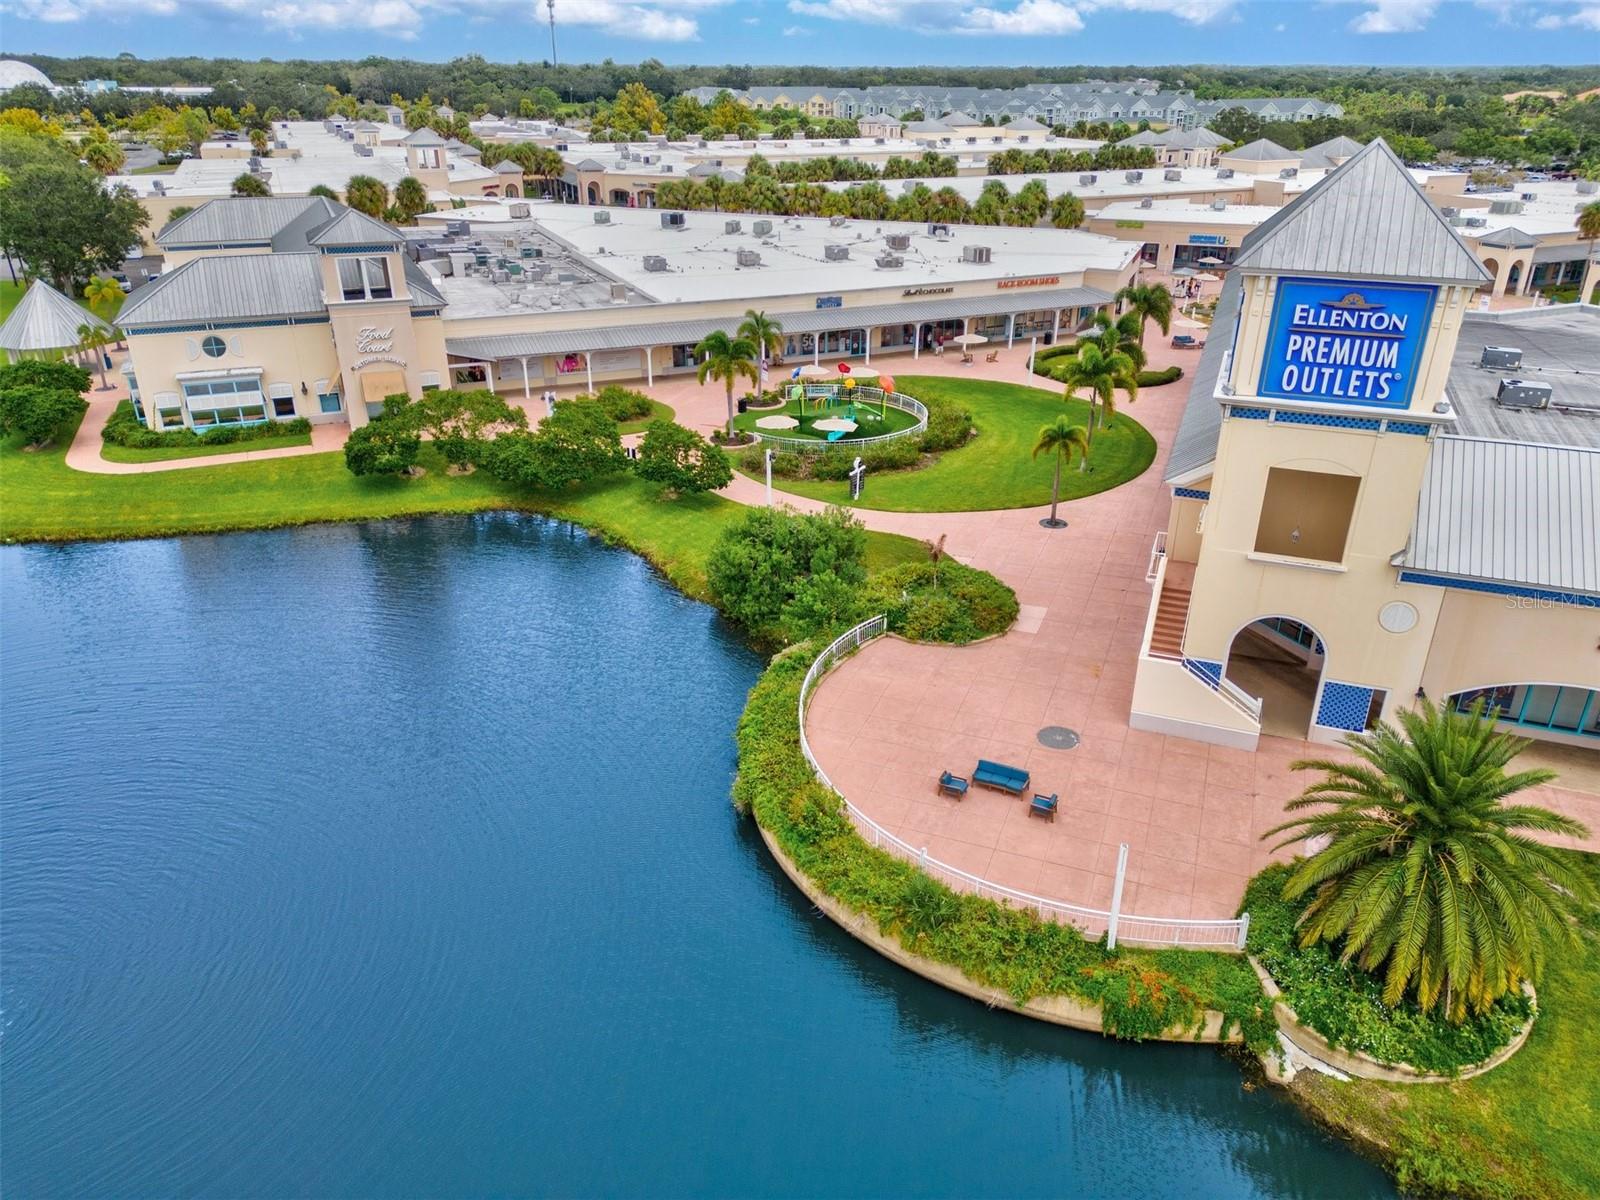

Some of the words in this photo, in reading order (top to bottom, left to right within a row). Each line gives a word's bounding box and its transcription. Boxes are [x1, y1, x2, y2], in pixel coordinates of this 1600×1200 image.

[1293, 304, 1408, 332] ELLENTON
[358, 326, 393, 340] Food
[355, 339, 393, 353] Court
[1286, 334, 1399, 369] PREMIUM
